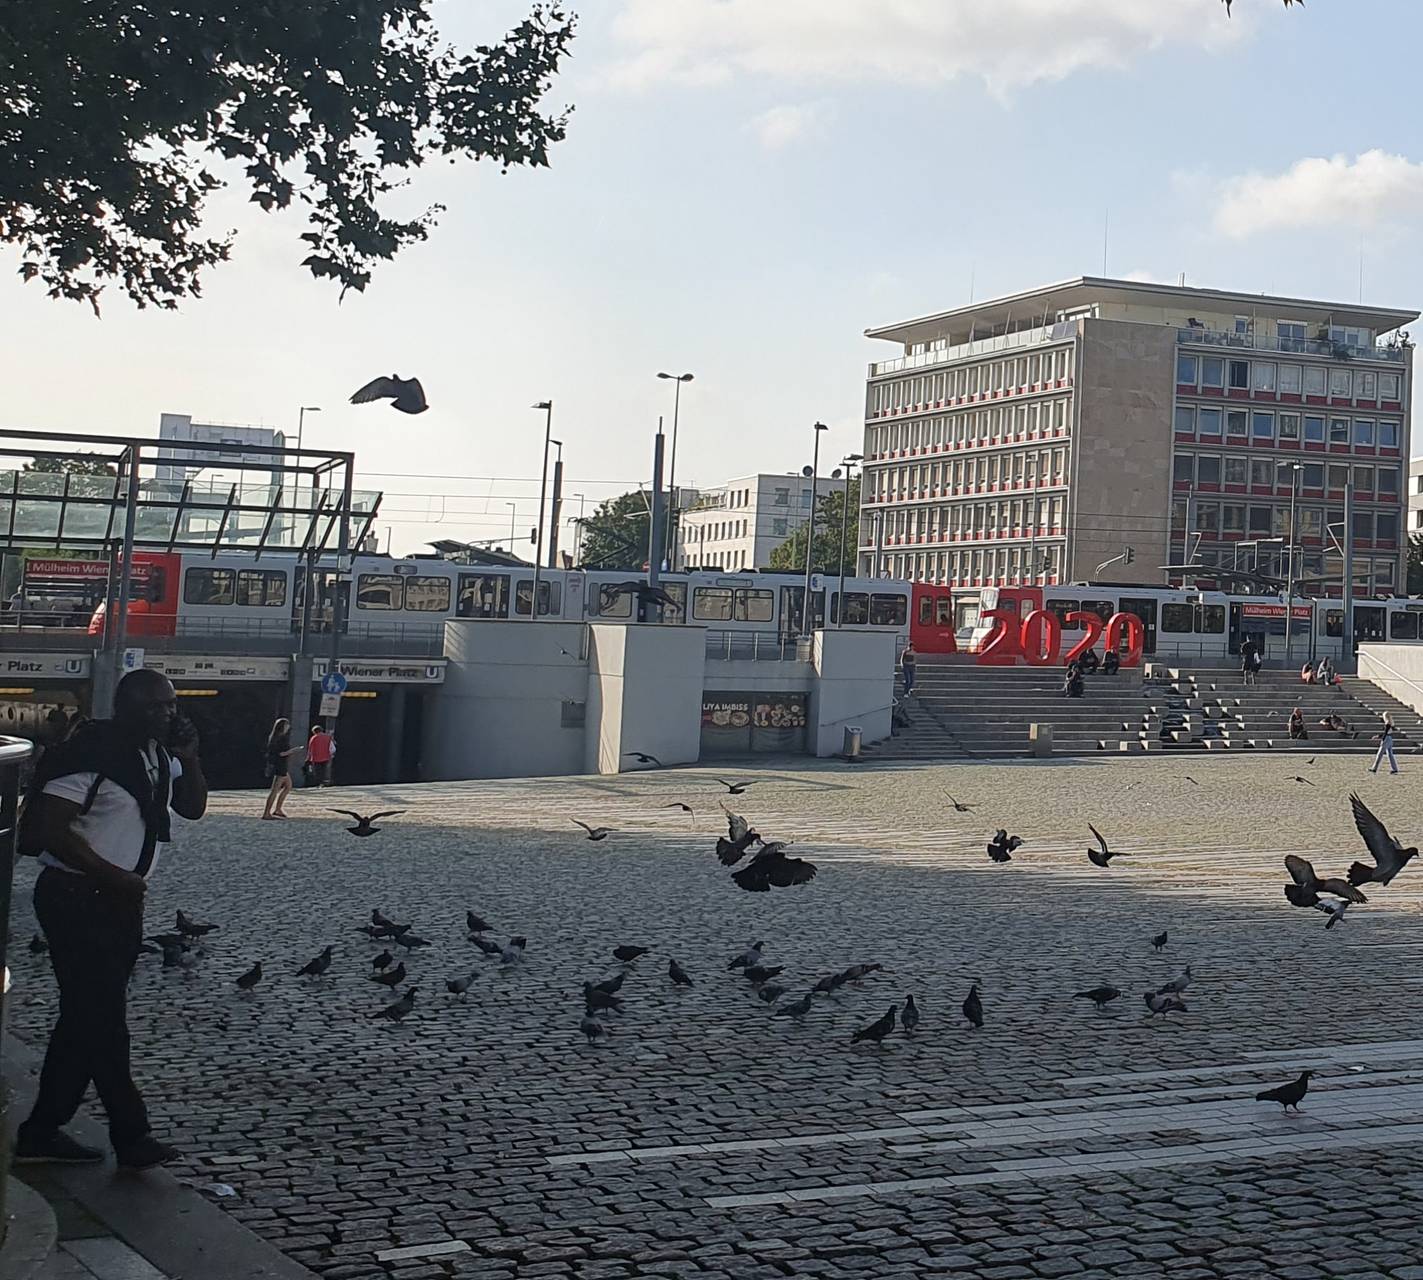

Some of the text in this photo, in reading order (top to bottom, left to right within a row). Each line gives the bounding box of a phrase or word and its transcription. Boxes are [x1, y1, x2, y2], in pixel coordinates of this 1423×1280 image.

[32, 562, 79, 573] Mülheim
[1245, 606, 1272, 615] Mülheim
[1294, 608, 1308, 616] Platz
[975, 609, 1144, 667] 2020
[8, 661, 42, 672] Platz
[341, 664, 383, 677] Wiener
[388, 667, 417, 677] Platz
